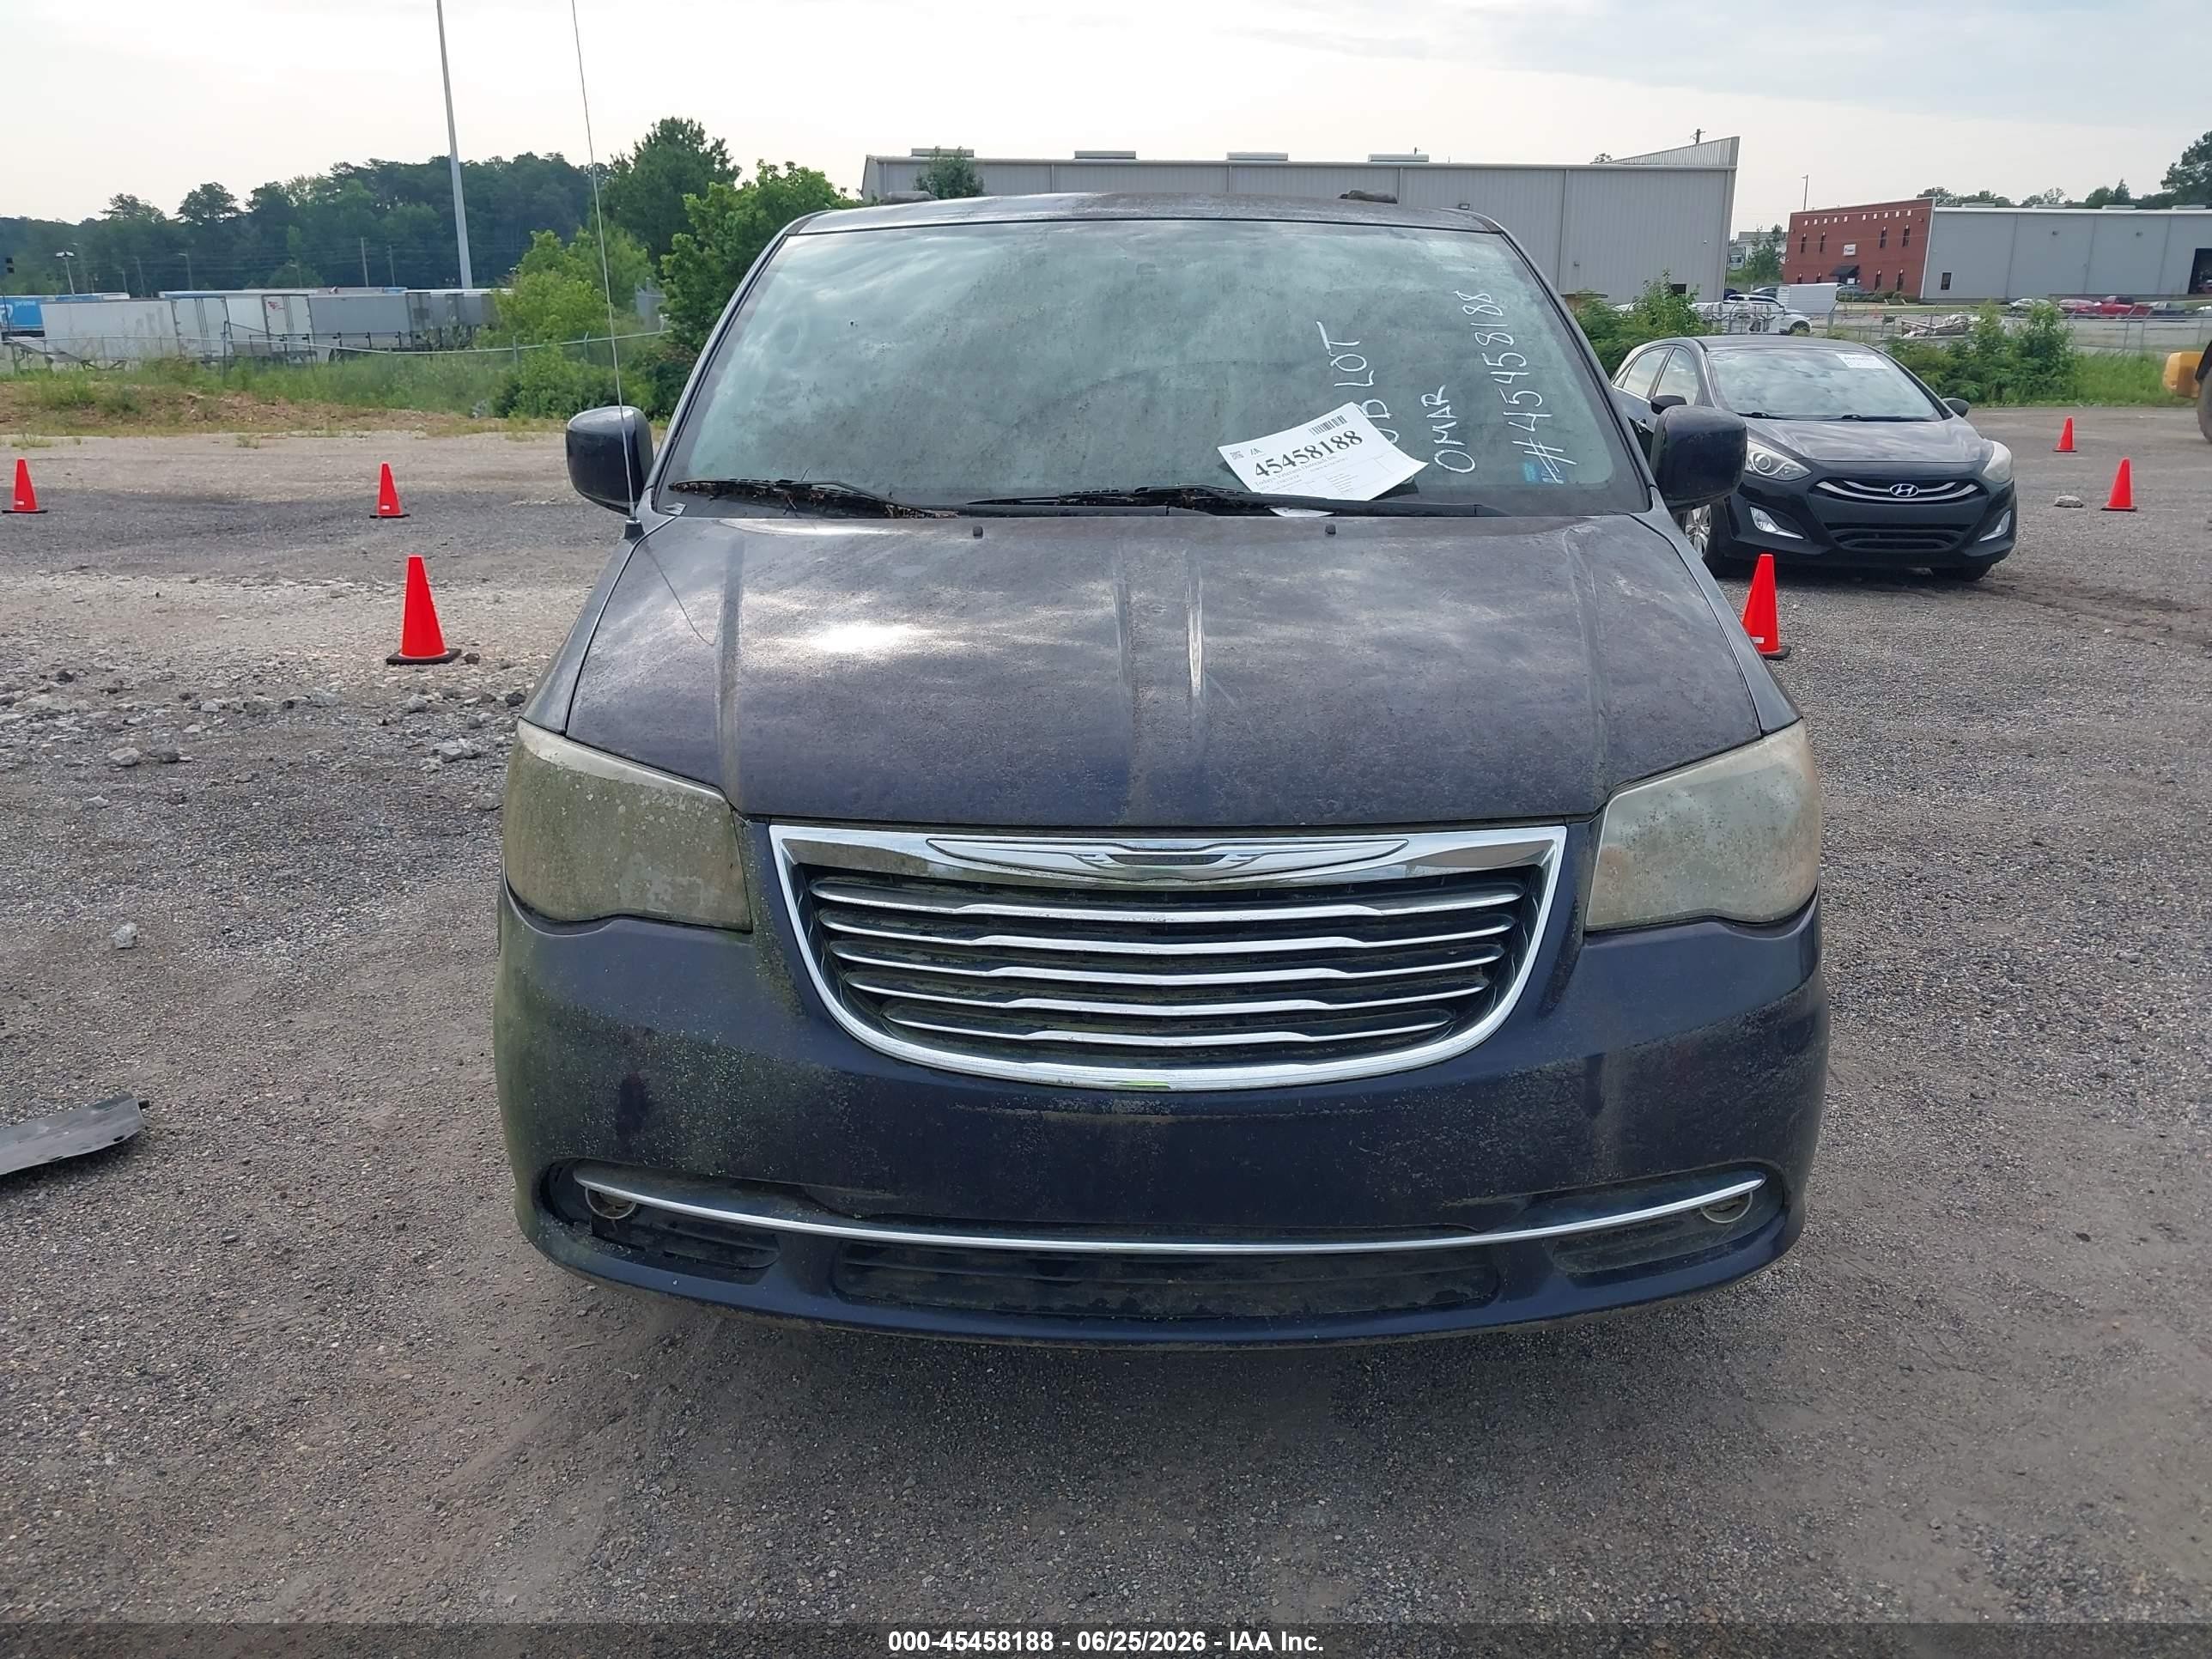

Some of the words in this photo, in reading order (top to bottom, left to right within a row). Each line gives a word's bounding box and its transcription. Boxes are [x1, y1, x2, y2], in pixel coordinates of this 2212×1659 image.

[1316, 320, 1375, 386] LOT
[1255, 430, 1363, 477] 45458188
[1420, 384, 1476, 473] OMAR
